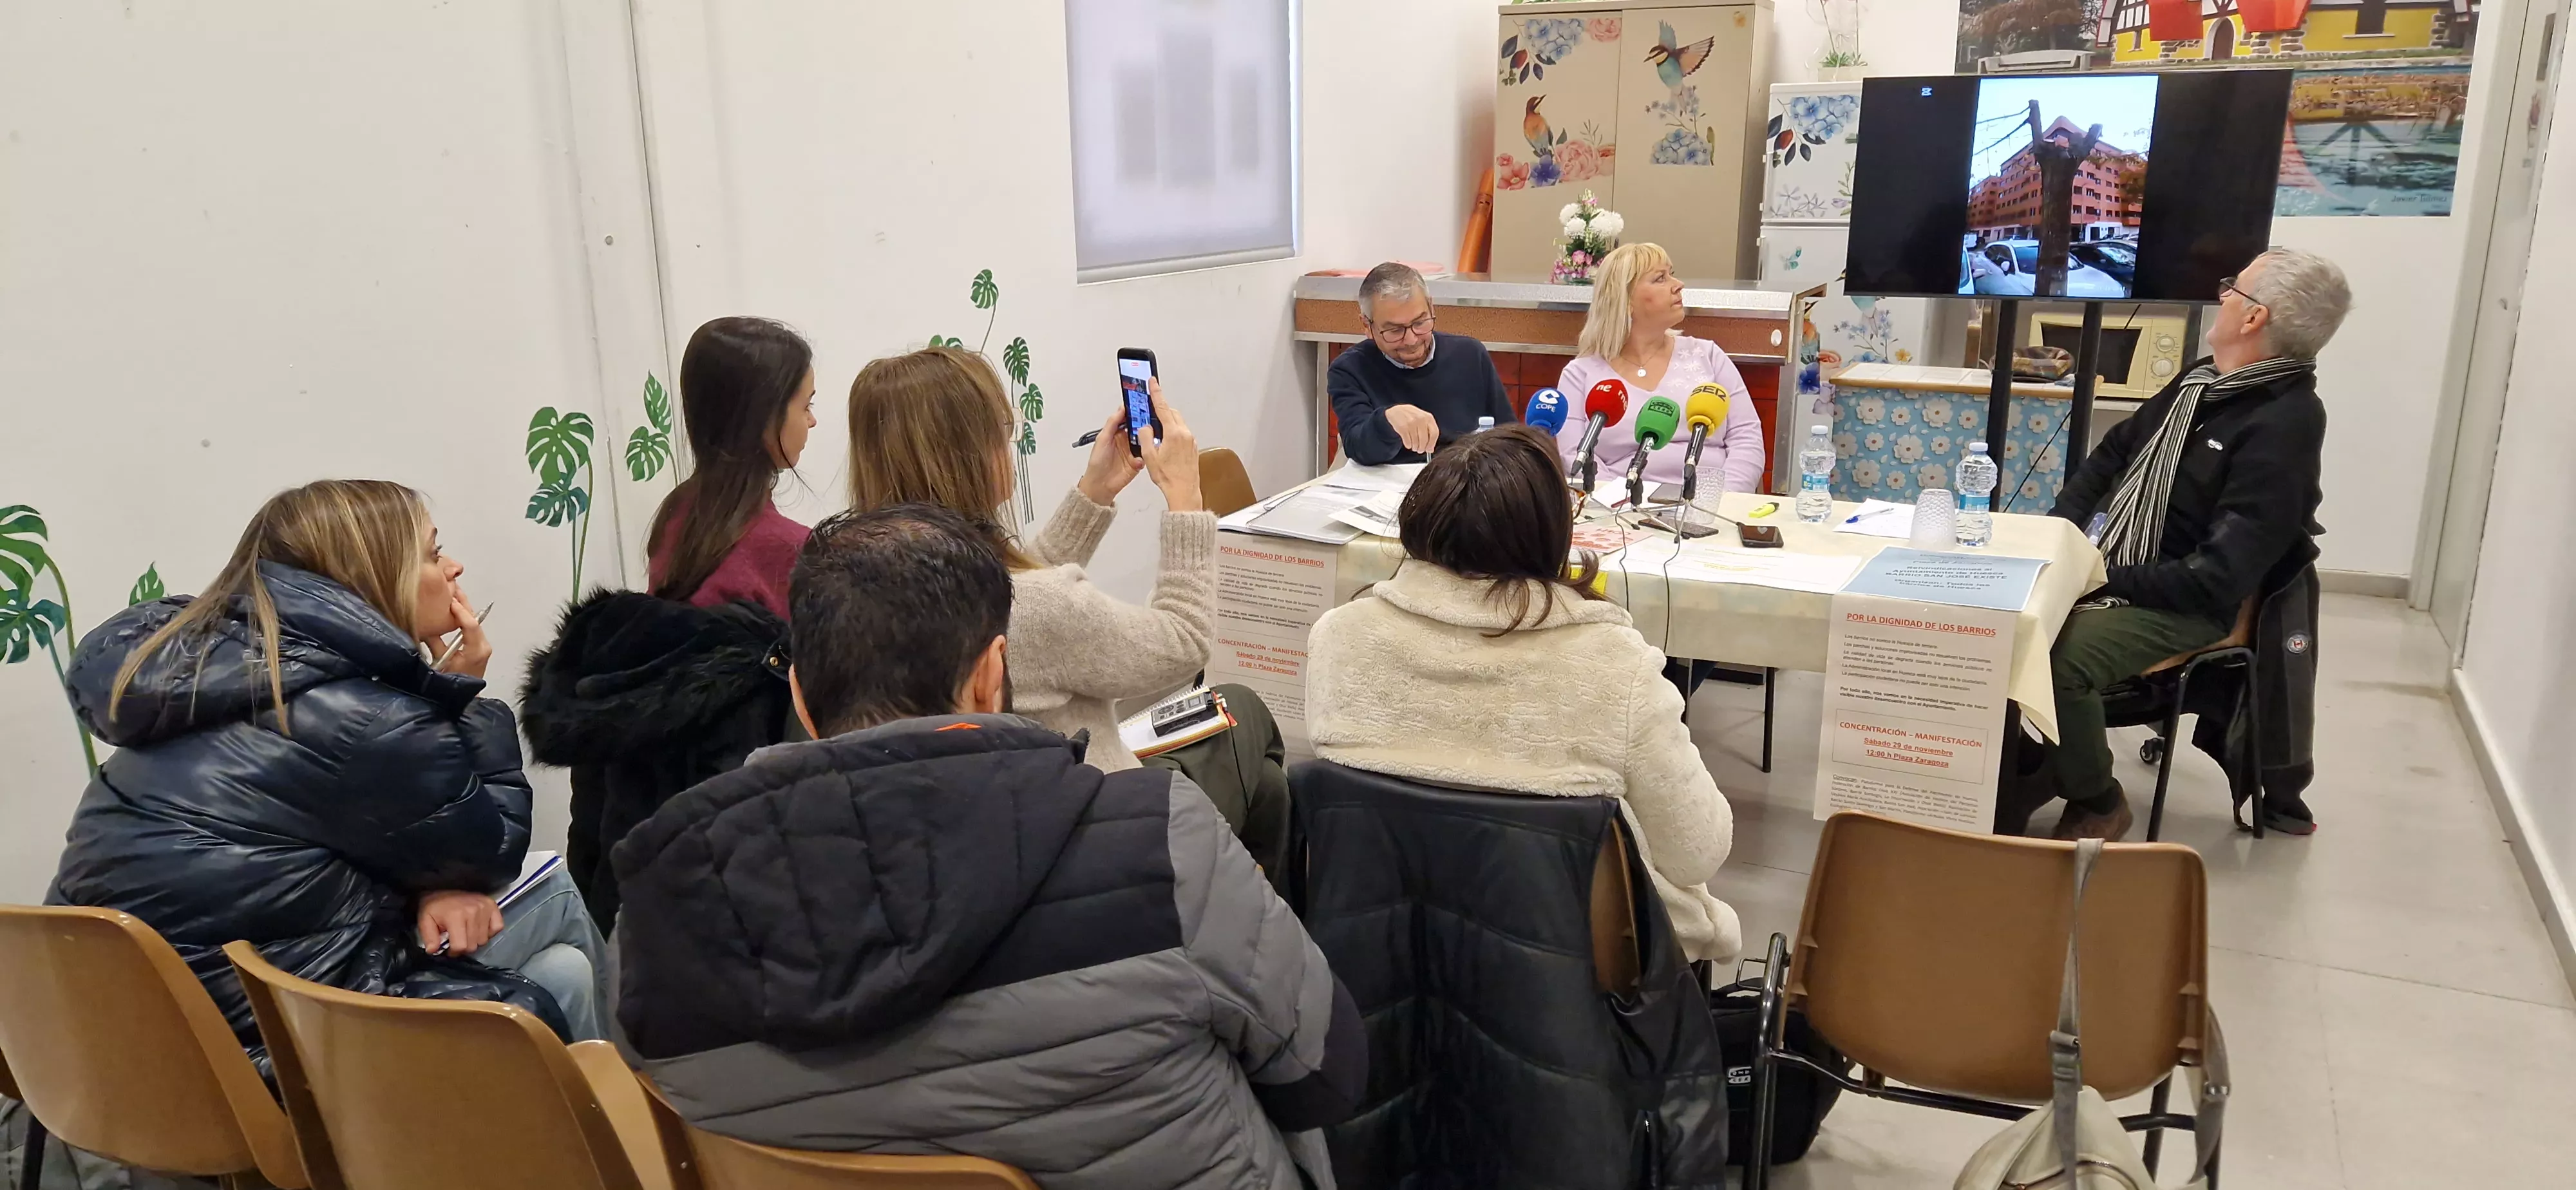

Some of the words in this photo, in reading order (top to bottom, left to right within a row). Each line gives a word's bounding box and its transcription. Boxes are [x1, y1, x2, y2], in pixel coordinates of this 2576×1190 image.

[1690, 386, 1727, 402] SER
[1535, 404, 1556, 413] COPE
[1242, 549, 1273, 559] DIGNIDAD
[1297, 557, 1324, 567] BARRIOS
[1846, 612, 1864, 621] POR
[1879, 616, 1922, 627] DIGNIDAD
[1938, 623, 1954, 631] LOS
[1957, 625, 1996, 636] BARRIOS
[1218, 638, 1265, 650] CONCENTRACIÓN
[1272, 646, 1308, 657] MANIFESTAC
[1839, 721, 1906, 737] CONCENTRACIÓN
[1915, 731, 1982, 748] MANIFESTACIÓN
[1864, 737, 1891, 747] Sábado
[1914, 744, 1953, 756] noviembre
[1866, 749, 1885, 758] 12:00
[1893, 753, 1912, 762] Plaza
[1914, 756, 1949, 767] Zaragoza
